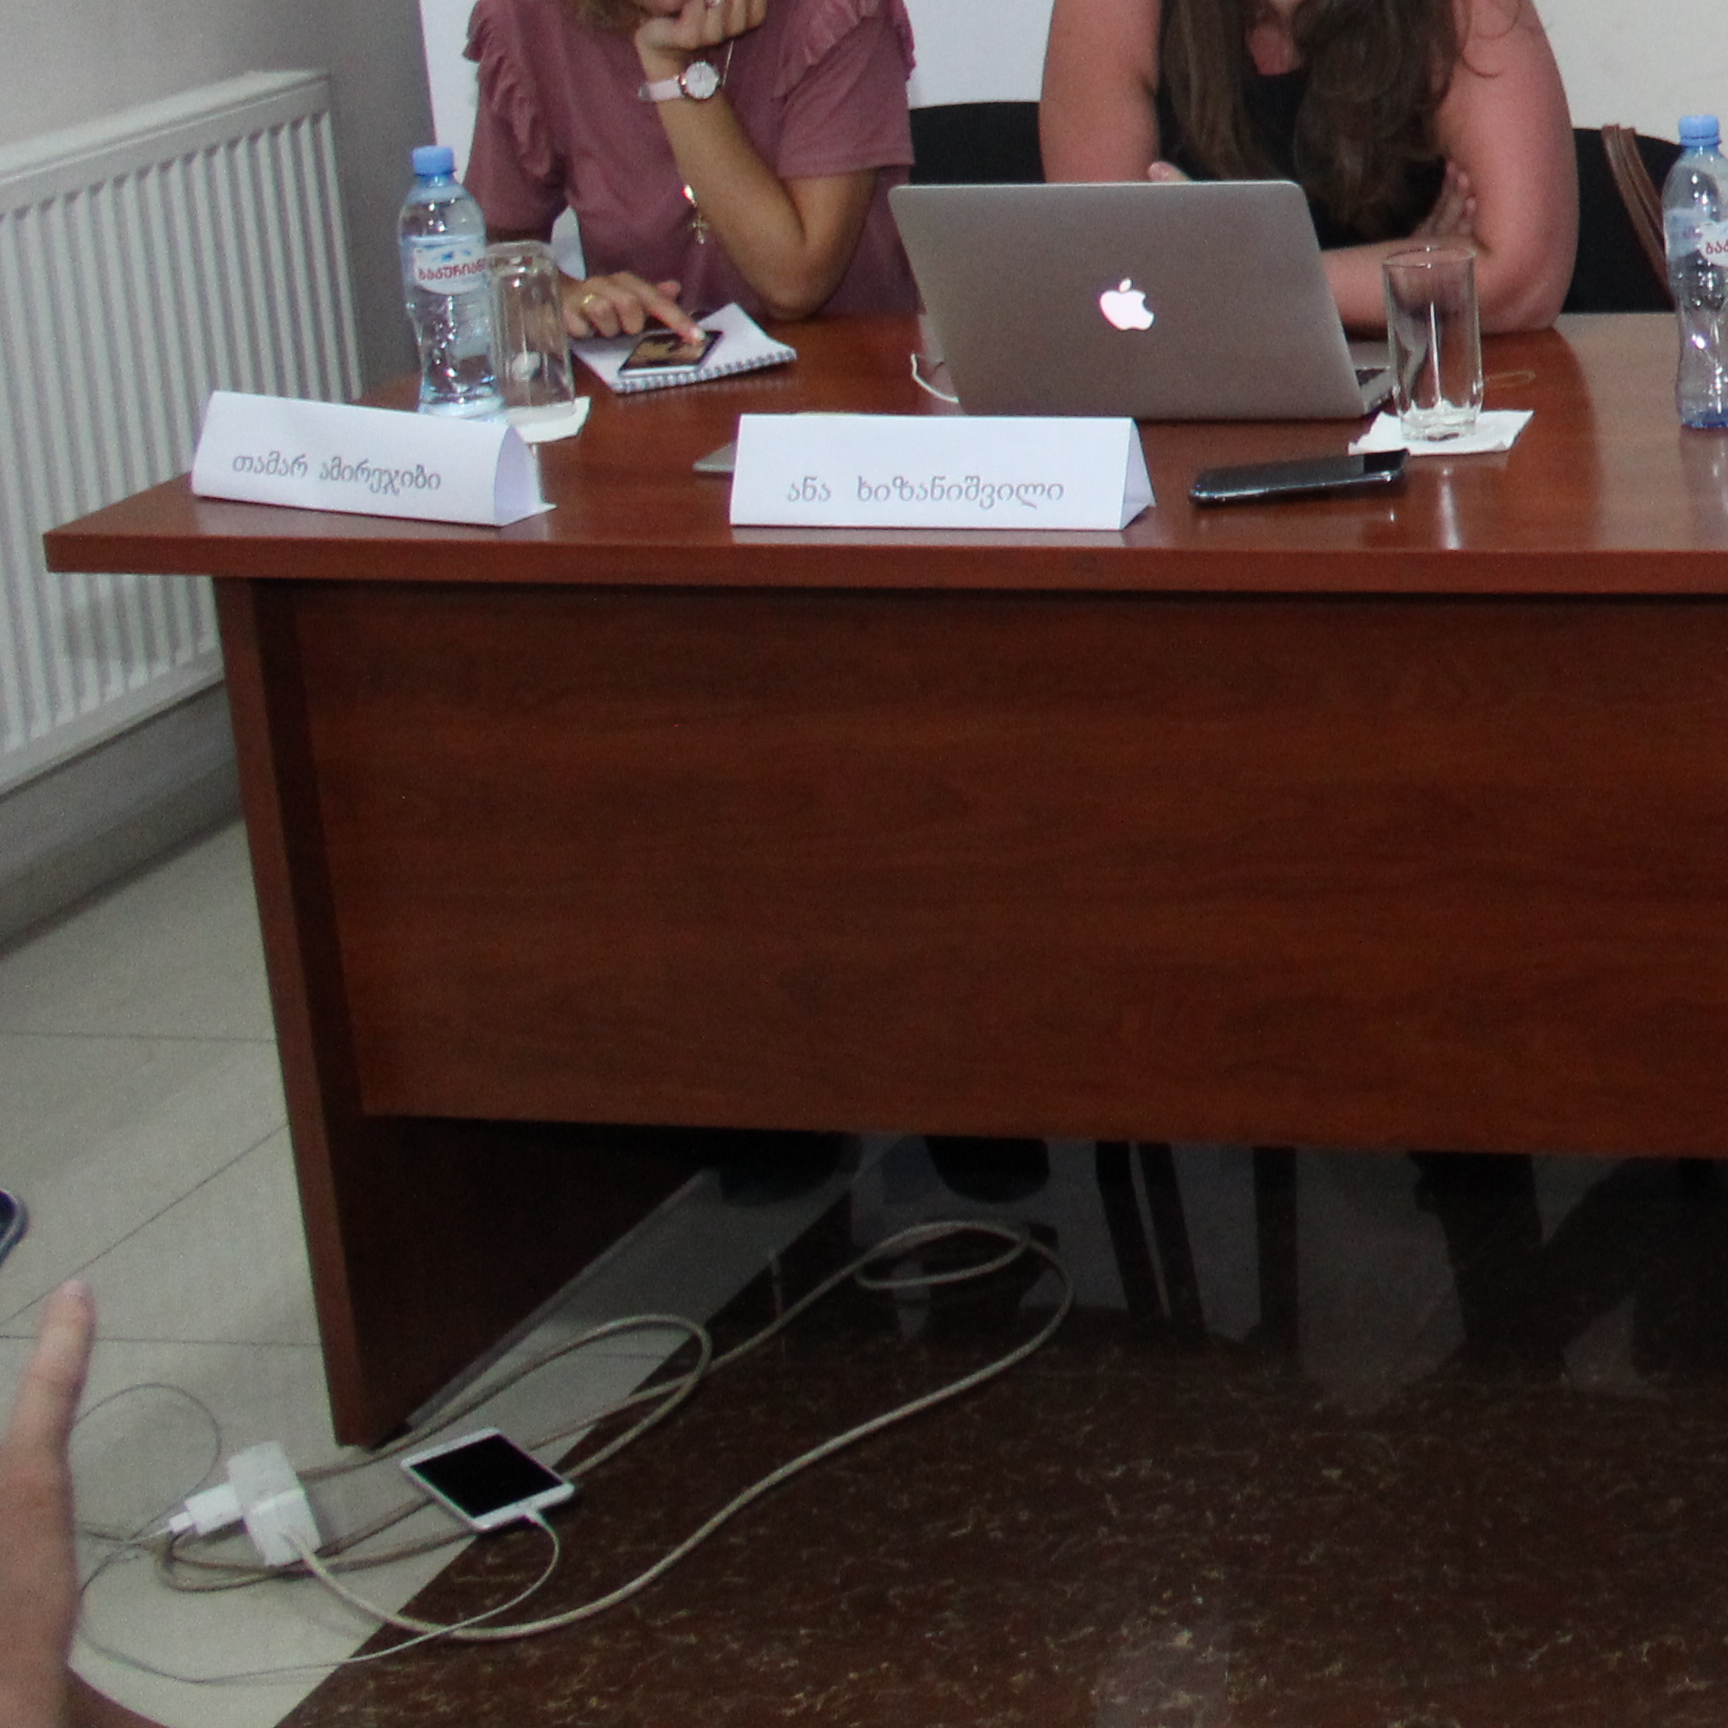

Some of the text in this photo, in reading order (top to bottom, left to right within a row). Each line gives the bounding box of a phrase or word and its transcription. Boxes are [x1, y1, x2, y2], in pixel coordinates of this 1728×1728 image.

[231, 450, 442, 497] თამარ ამირეჯიბი
[787, 474, 1066, 510] ანა ხიზანიშვილი
